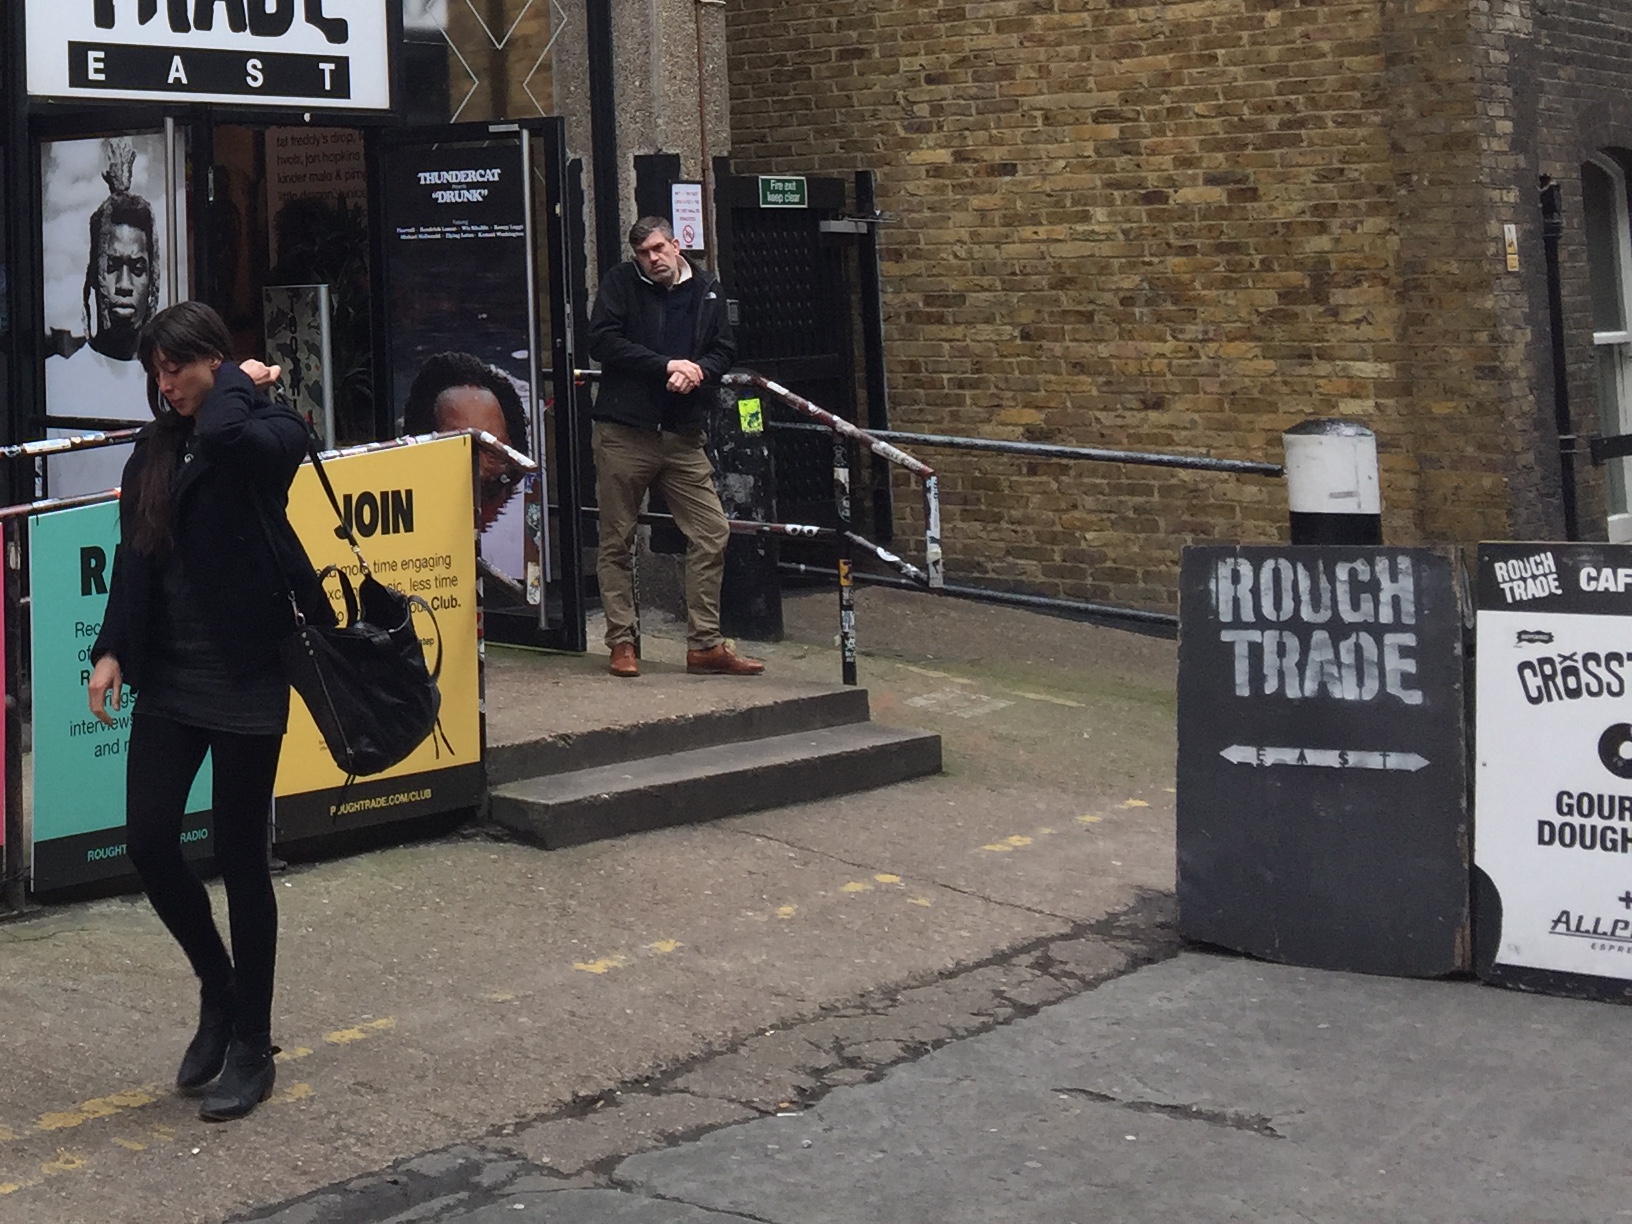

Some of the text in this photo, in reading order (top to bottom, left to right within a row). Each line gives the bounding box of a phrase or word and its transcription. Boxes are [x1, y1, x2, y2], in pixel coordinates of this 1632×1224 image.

[87, 50, 336, 91] EAST
[417, 169, 501, 184] THUNDERCAT
[770, 179, 796, 190] Fire exit
[766, 191, 800, 204] keep clear
[333, 488, 415, 540] JOIN
[373, 559, 398, 574] time
[400, 554, 452, 572] engaging
[1494, 551, 1557, 583] ROUGH
[409, 577, 432, 592] less
[434, 575, 458, 589] time
[1216, 555, 1417, 625] ROUGH
[1499, 574, 1563, 604] TRADE
[430, 595, 462, 610] Club.
[1219, 629, 1423, 705] TRADE
[1517, 651, 1632, 706] CROSS
[94, 738, 120, 757] and
[1255, 747, 1390, 769] EAST
[330, 789, 432, 816] RUGHTRADE.COM/CLUB
[1551, 909, 1632, 939] ALLP
